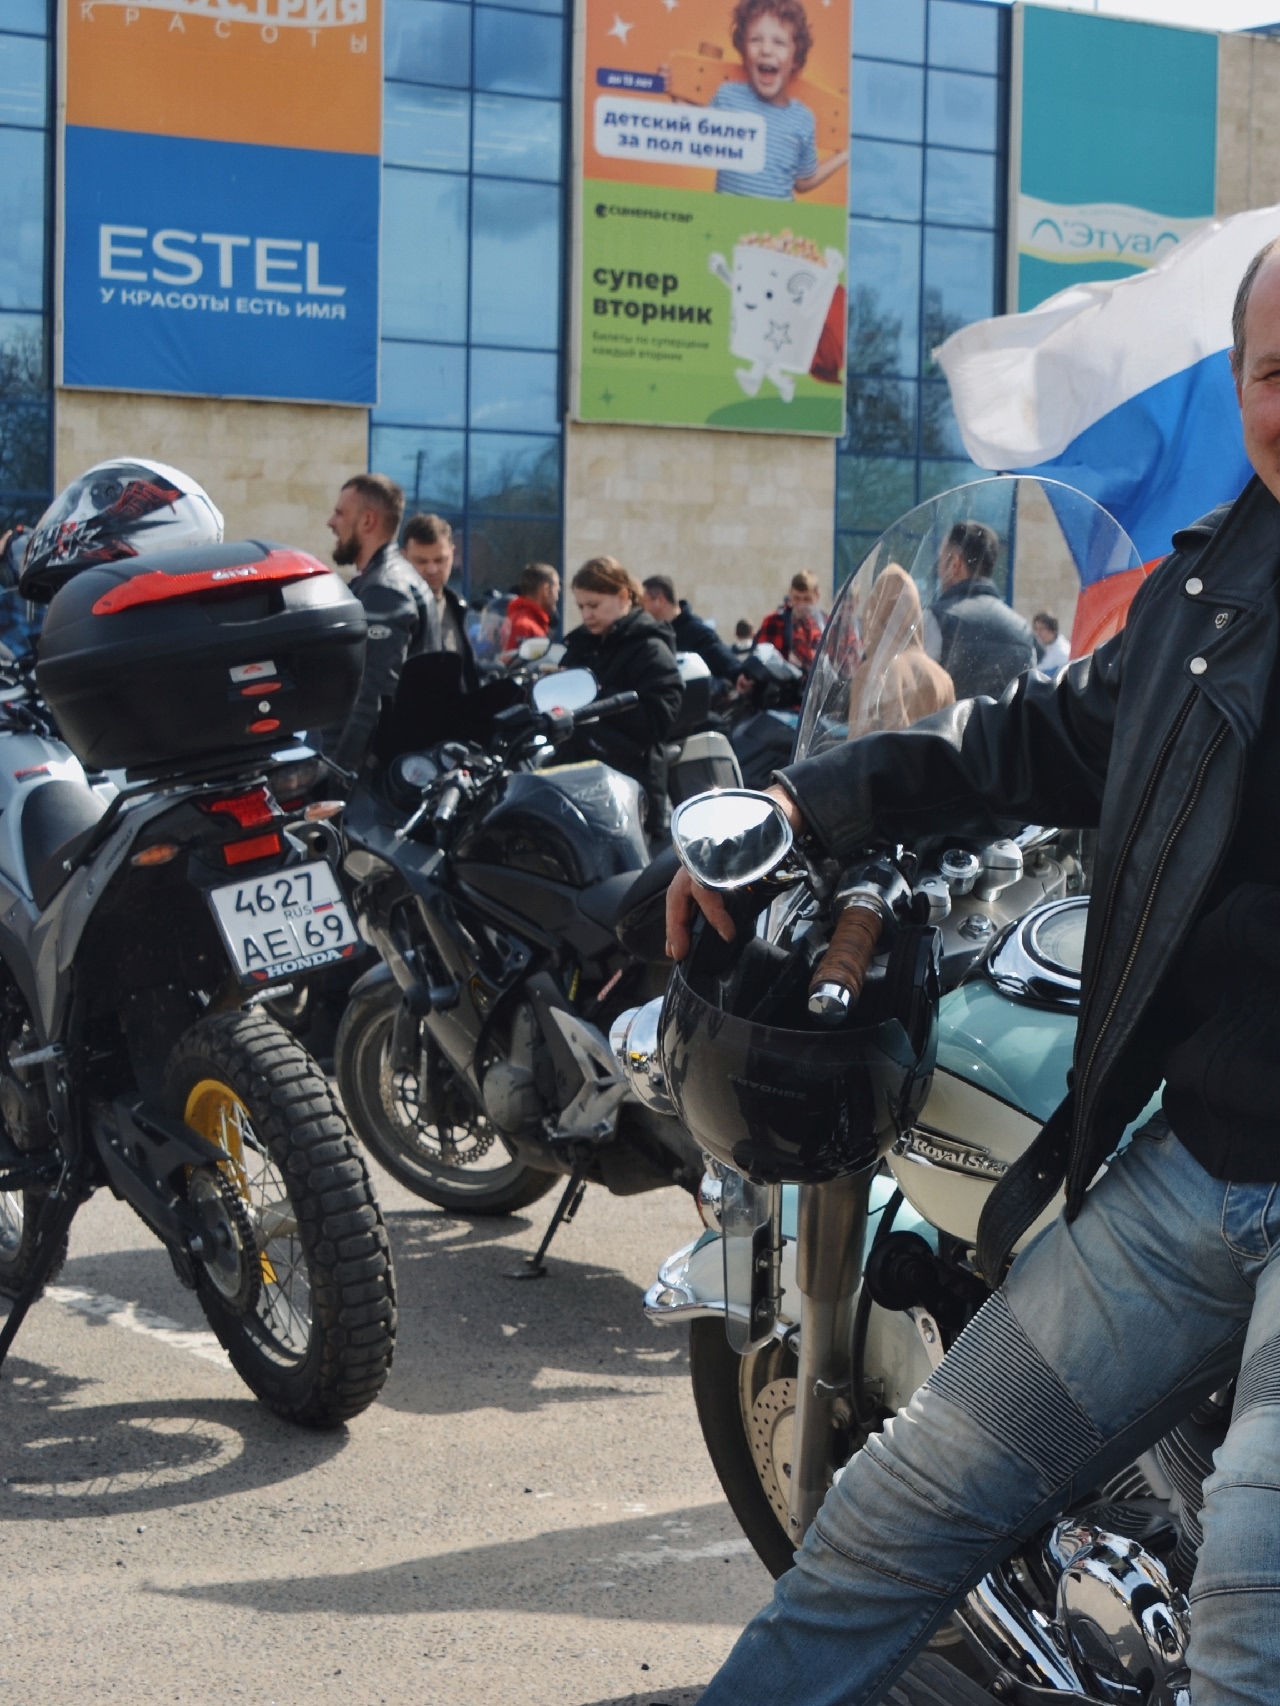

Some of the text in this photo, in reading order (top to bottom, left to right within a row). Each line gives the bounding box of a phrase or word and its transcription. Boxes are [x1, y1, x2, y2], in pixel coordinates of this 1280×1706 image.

[604, 111, 758, 141] детский билет
[618, 133, 743, 160] за пол цены
[100, 224, 346, 296] ESTEL
[593, 267, 678, 296] супер
[101, 288, 346, 320] У КРАСОТЫ ЕСТЬ ИМЯ
[593, 297, 713, 326] вторник
[235, 872, 312, 916] 4627
[284, 905, 312, 920] RUS
[243, 914, 343, 967] AE 69
[266, 949, 343, 978] HONDA
[912, 1136, 965, 1166] Royal
